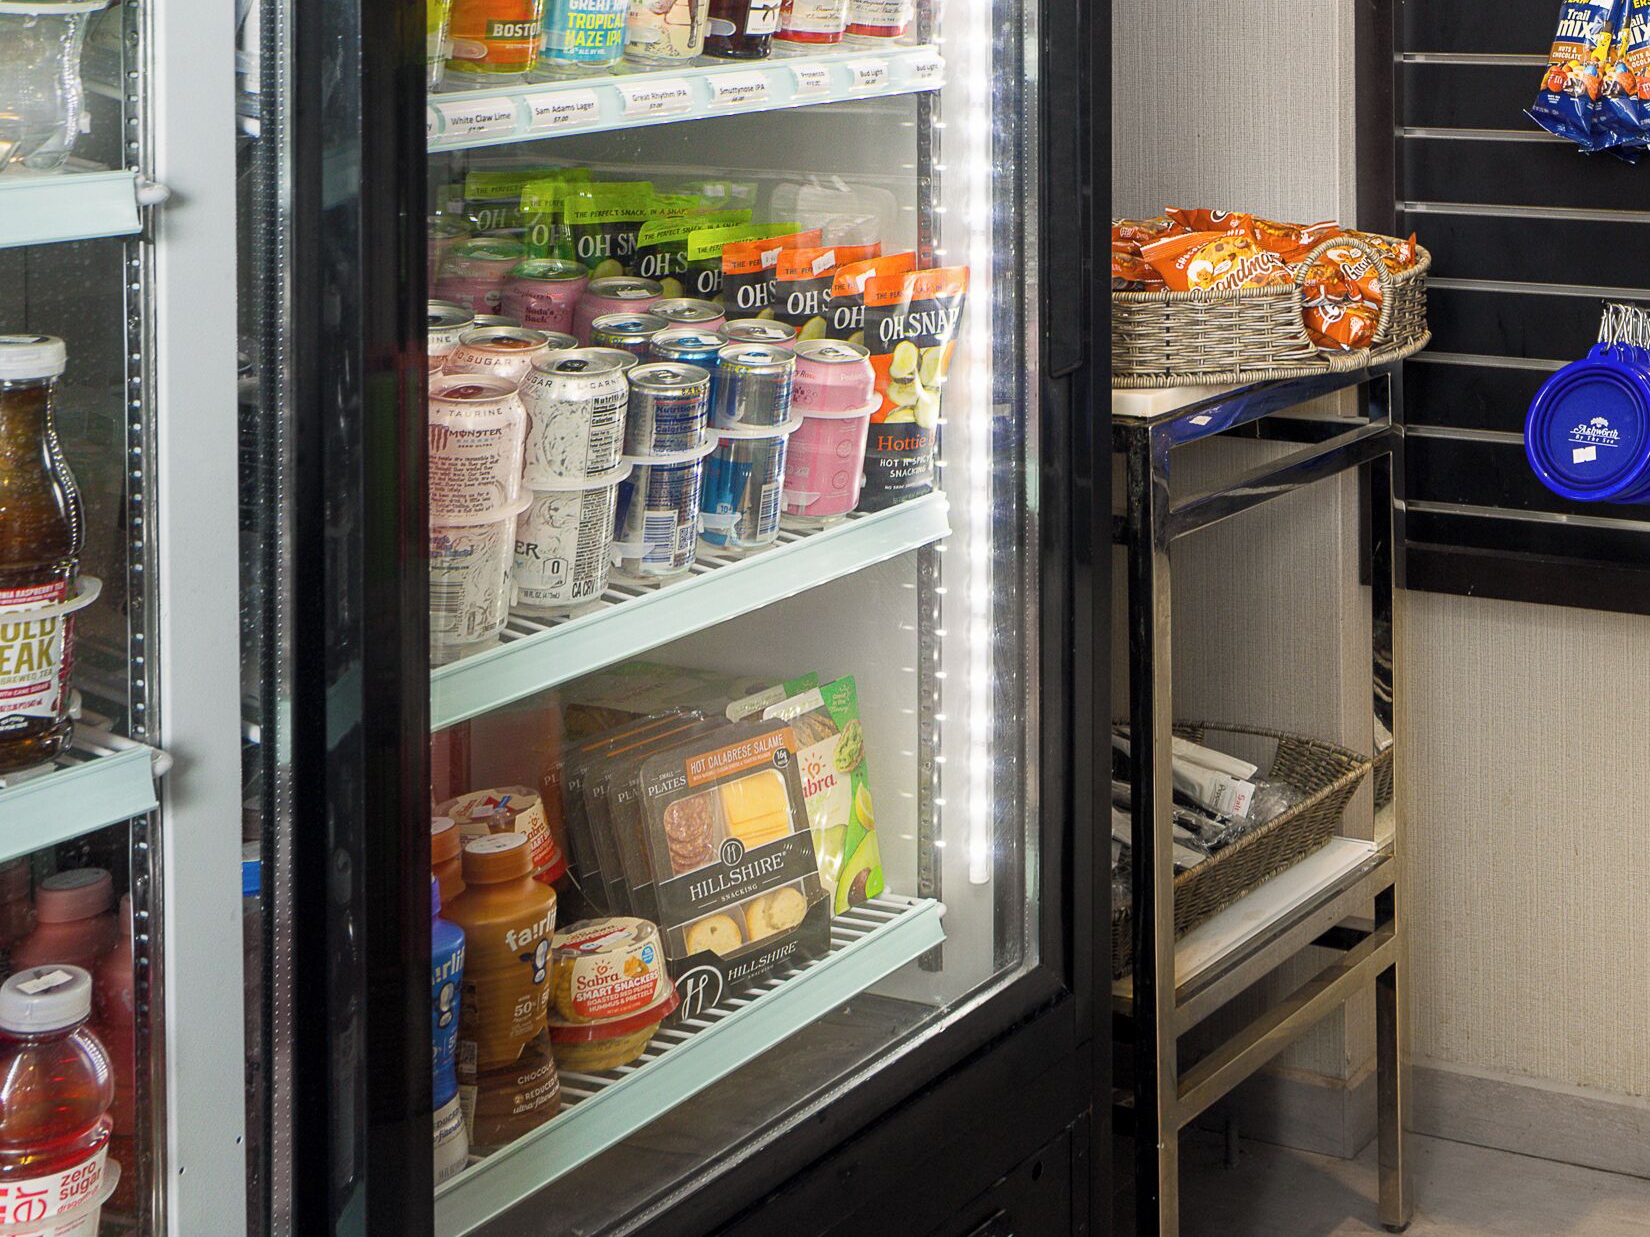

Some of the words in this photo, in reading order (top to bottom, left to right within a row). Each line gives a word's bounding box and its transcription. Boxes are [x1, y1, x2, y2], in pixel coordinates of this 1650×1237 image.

[567, 12, 626, 29] TROPICAL
[1567, 8, 1592, 22] Trail
[565, 29, 604, 47] HAZE
[605, 30, 622, 46] IPA
[1556, 19, 1597, 41] mix
[1552, 51, 1582, 61] CHOCOLATE
[1558, 45, 1573, 53] NUTS
[860, 69, 871, 78] Bud
[871, 67, 884, 78] Light
[916, 64, 927, 73] Bud
[927, 62, 940, 72] Light
[632, 93, 650, 103] Great
[651, 90, 676, 102] Rhythm
[676, 88, 688, 98] IPA
[720, 84, 754, 96] Smuttynose
[755, 82, 766, 92] IPA
[535, 106, 550, 116] Sam
[551, 105, 575, 115] Adams
[576, 102, 595, 114] Lager
[451, 115, 473, 126] White
[475, 113, 493, 124] Claw
[494, 112, 511, 122] Lime
[590, 210, 619, 218] PERFECT
[658, 228, 682, 240] PERFECT
[577, 233, 612, 258] OH
[641, 254, 670, 278] OH
[737, 283, 769, 309] OH
[786, 289, 818, 316] OH
[833, 305, 866, 331] OH
[879, 314, 906, 344] OH
[449, 407, 503, 417] TAURINE
[1571, 423, 1619, 439] Ashworth
[877, 434, 927, 452] Hottie
[880, 457, 899, 468] HOT
[889, 464, 927, 479] SNACKING
[571, 581, 583, 599] CA
[690, 761, 707, 775] HOT
[708, 743, 753, 770] CALABRESE
[753, 733, 784, 755] SALAME
[775, 749, 787, 762] 16g
[647, 775, 687, 796] PLATES
[658, 771, 675, 782] SMALL
[1217, 782, 1227, 809] Pepper
[1232, 792, 1247, 813] Salt
[689, 853, 785, 902] HILLSHIRE
[720, 883, 759, 903] SNACKING
[728, 944, 797, 981] HILLSHIRE
[575, 984, 613, 1003] SMART
[613, 970, 660, 990] SNACKERS
[576, 970, 619, 991] Sabra
[587, 991, 619, 1007] ROASTED
[619, 989, 632, 1000] RED
[632, 983, 655, 996] PEPPER
[588, 999, 620, 1014] HUMMUS
[625, 989, 654, 1005] PRETZELS
[524, 1079, 554, 1101] REDUCED
[60, 1161, 97, 1188] zero
[59, 1167, 102, 1202] sugar
